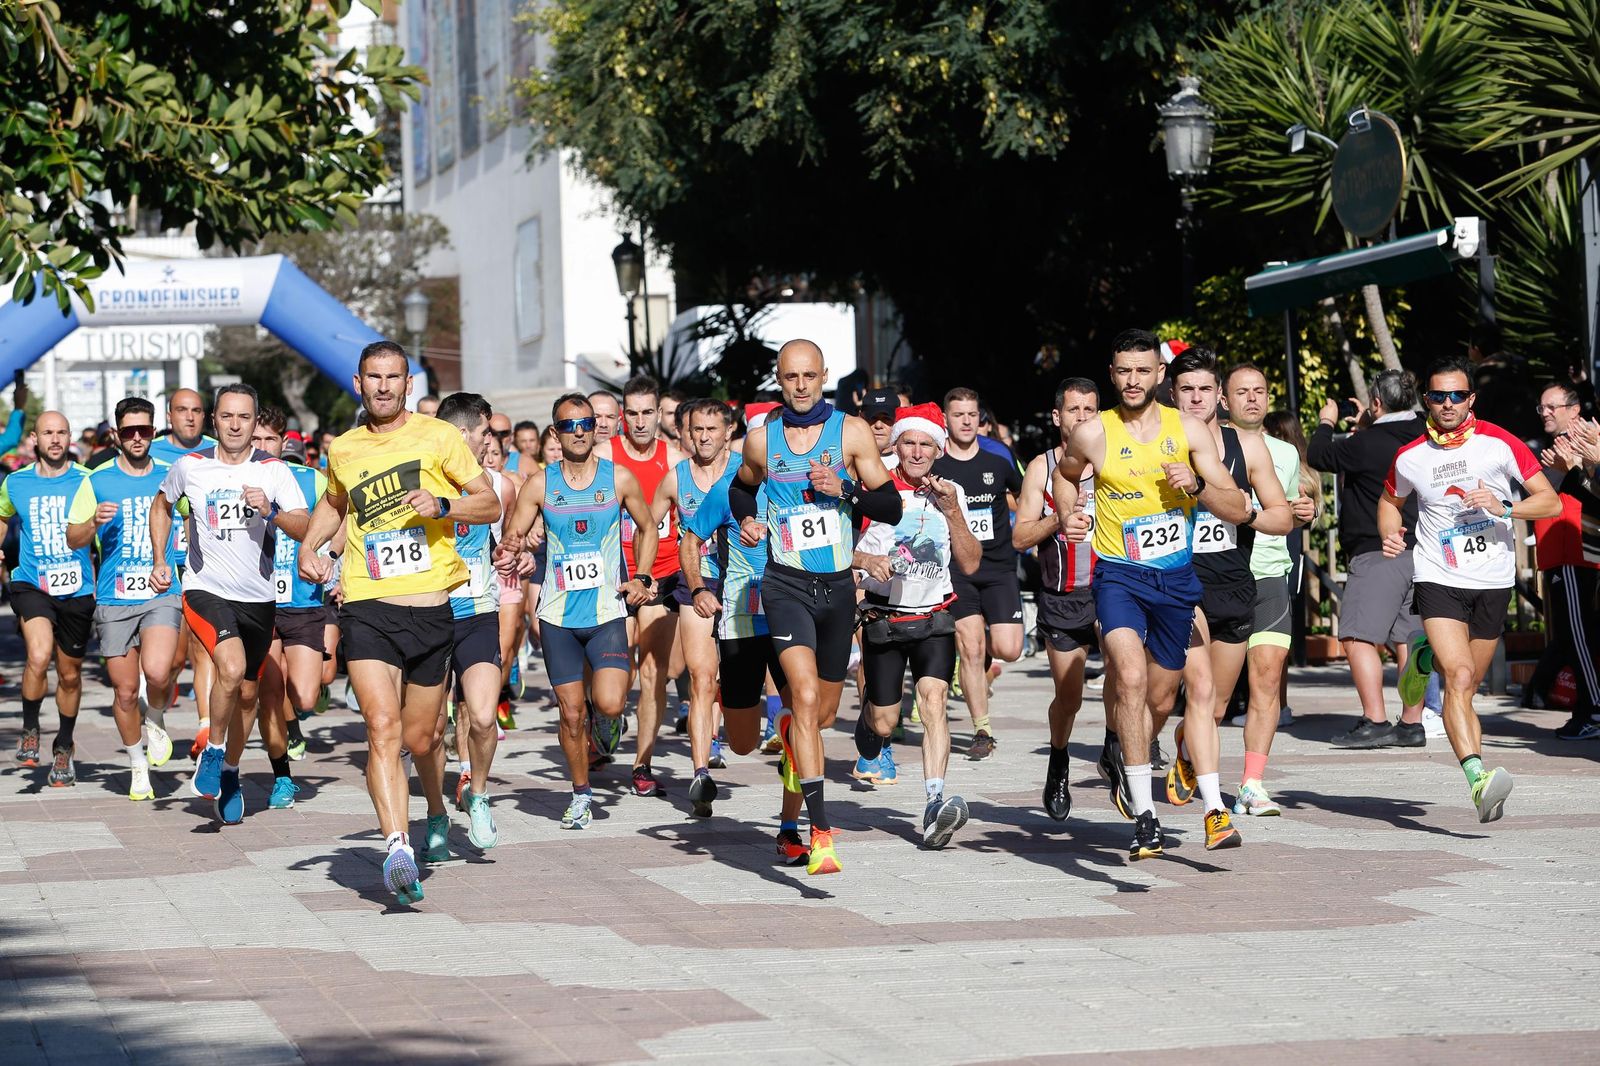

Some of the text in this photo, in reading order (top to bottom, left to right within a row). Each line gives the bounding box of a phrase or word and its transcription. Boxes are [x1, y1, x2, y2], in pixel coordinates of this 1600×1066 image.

[99, 287, 241, 309] CRONOFINISHER
[81, 330, 202, 361] TURISMO
[1438, 460, 1468, 474] CARRERA
[361, 471, 402, 506] XIII
[40, 495, 67, 508] SAN
[791, 501, 832, 513] CARRERA
[40, 507, 69, 524] SIL
[219, 503, 255, 520] 216
[390, 504, 411, 517] TARIFA
[1138, 508, 1183, 524] CARRERA
[29, 496, 41, 543] CARRERA
[121, 498, 133, 545] CARRERA
[801, 516, 827, 539] 81
[970, 519, 989, 533] 26
[1453, 520, 1495, 535] CARRERA
[378, 527, 425, 541] CARRERA
[1140, 523, 1180, 549] 232
[1199, 523, 1225, 543] 26
[1463, 535, 1487, 555] 48
[380, 542, 423, 566] 218
[563, 550, 602, 560] CARRERA
[50, 571, 78, 587] 228
[565, 562, 599, 581] 103
[126, 576, 152, 591] 23
[276, 579, 287, 595] 9
